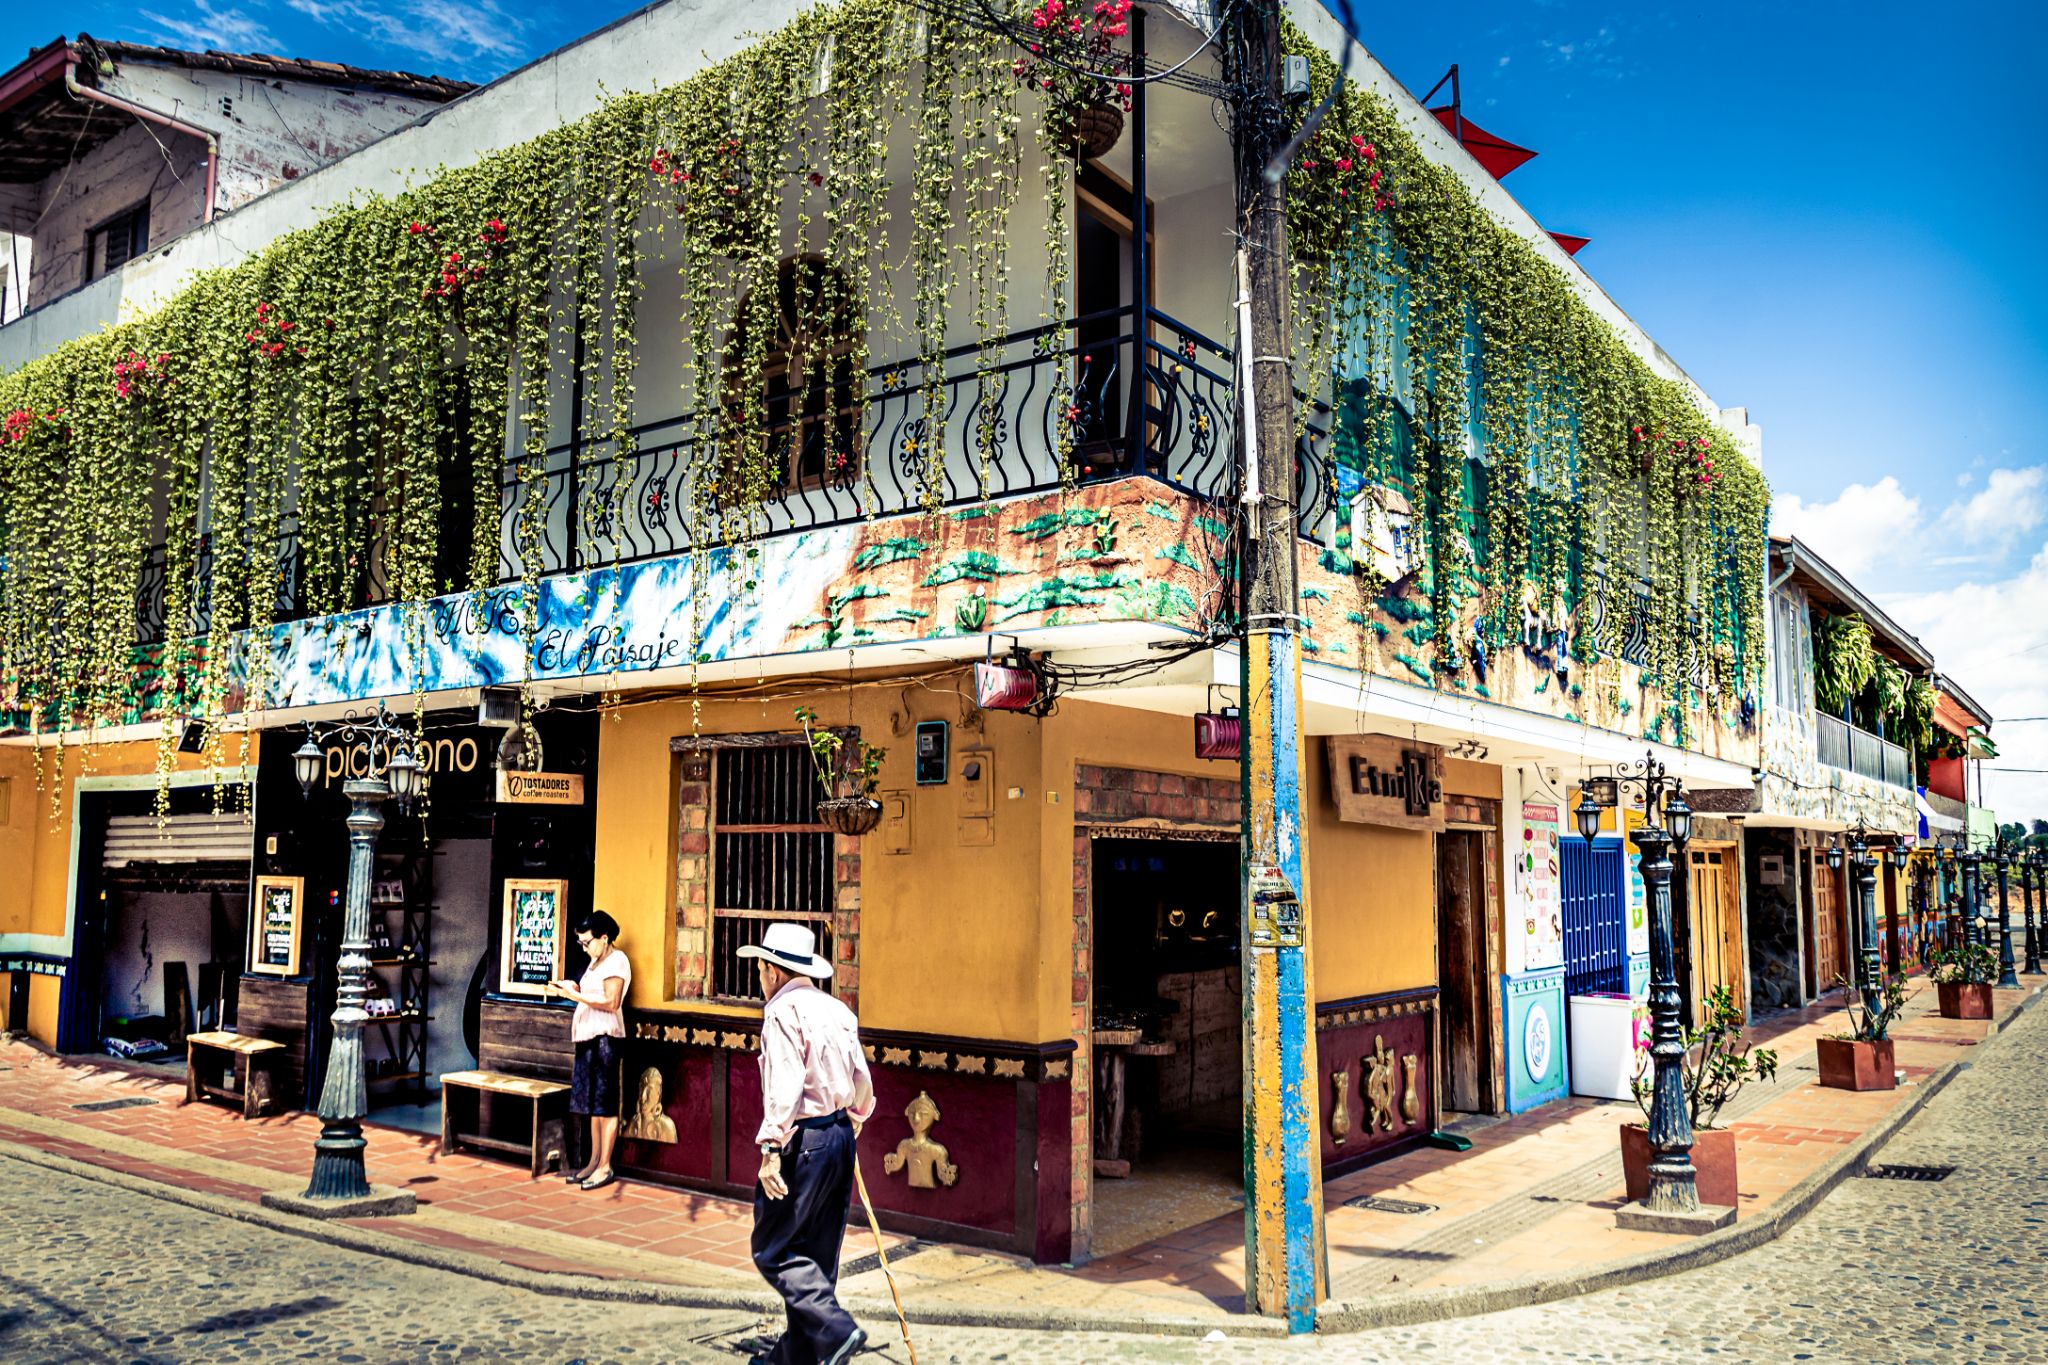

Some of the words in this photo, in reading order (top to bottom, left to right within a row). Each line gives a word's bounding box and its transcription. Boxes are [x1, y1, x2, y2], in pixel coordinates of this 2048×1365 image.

[538, 629, 573, 671] El
[577, 624, 680, 672] Paisaje
[523, 778, 570, 790] TOSTADORES
[523, 789, 542, 798] coffee
[544, 791, 569, 799] roasters
